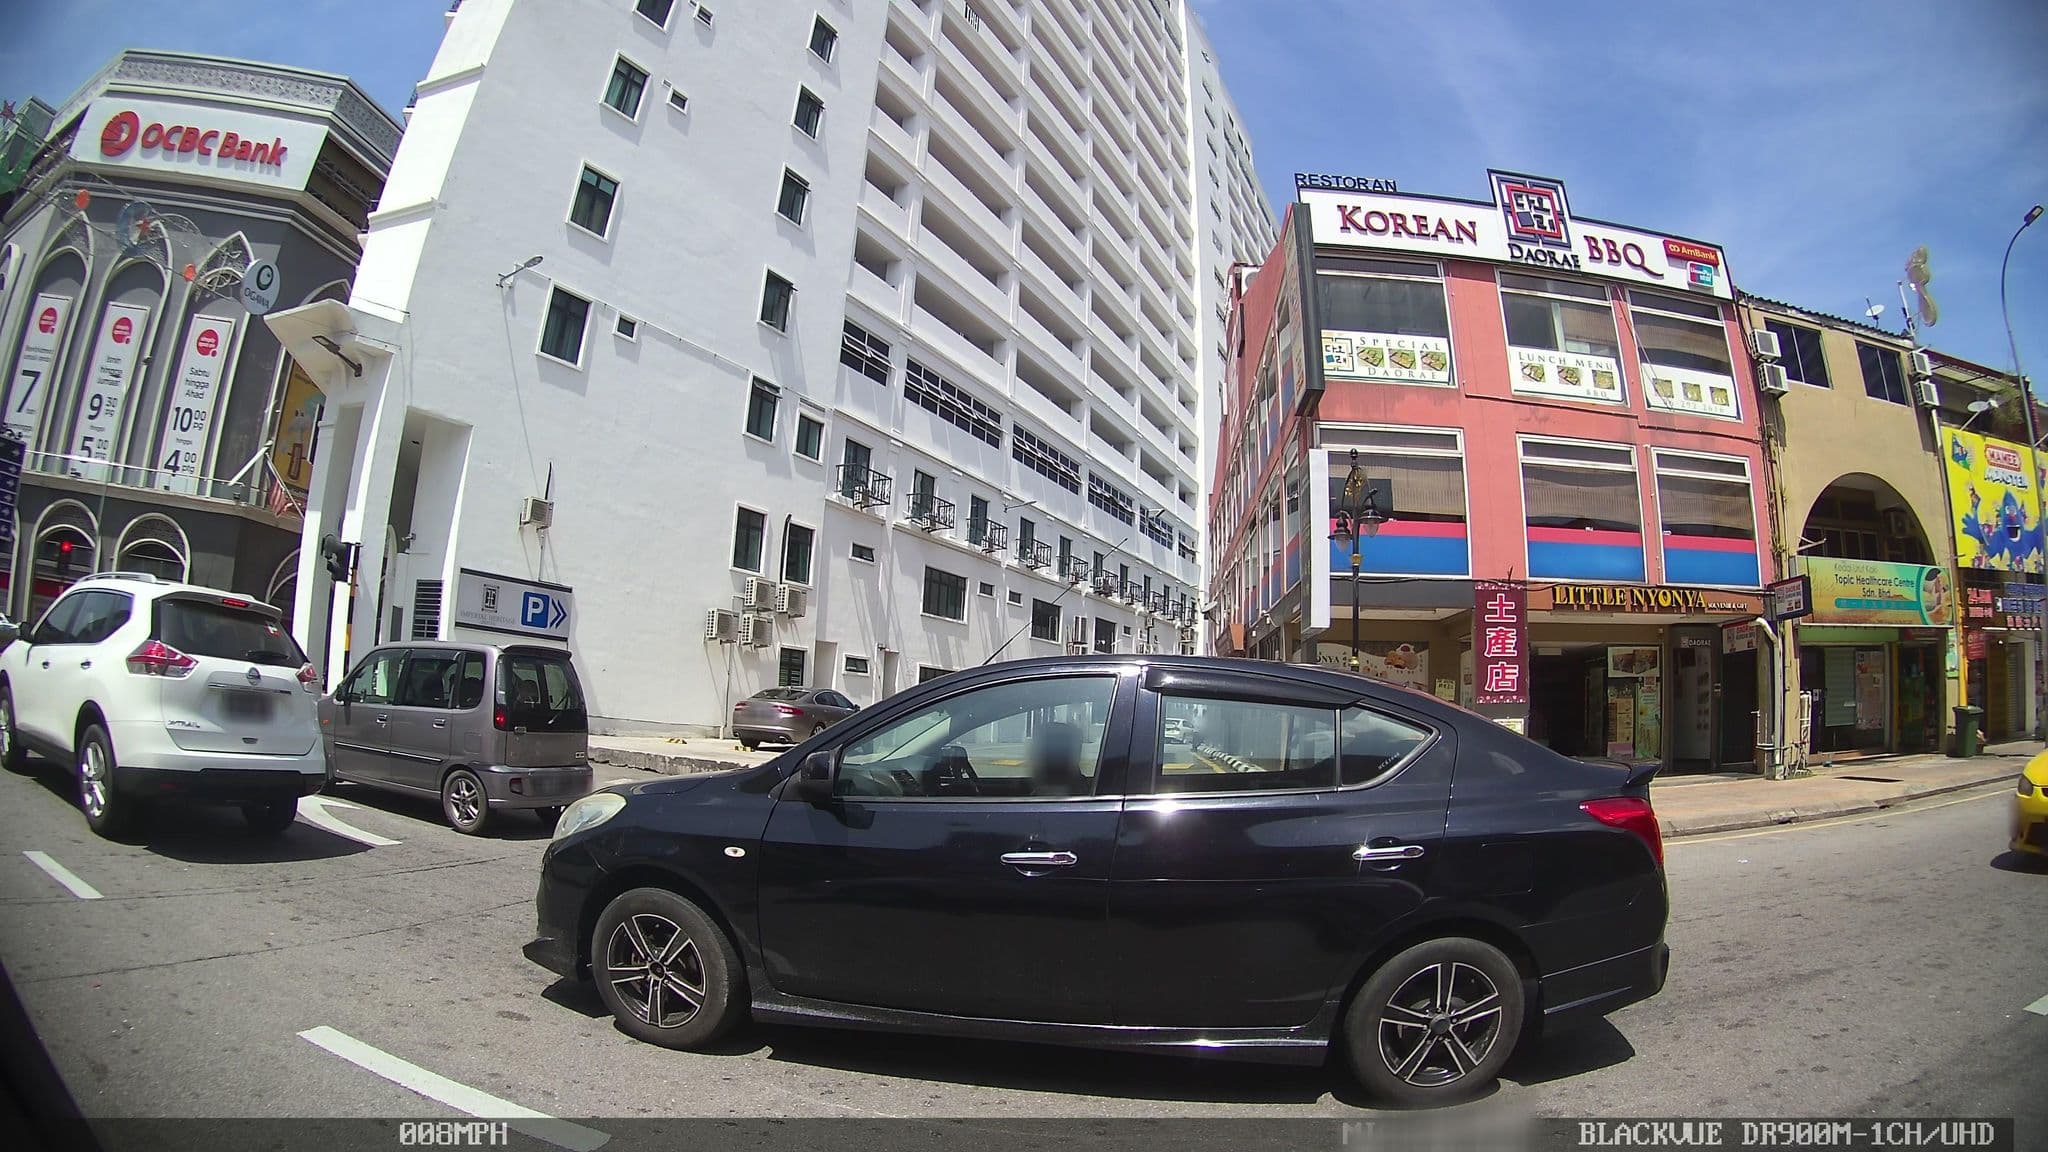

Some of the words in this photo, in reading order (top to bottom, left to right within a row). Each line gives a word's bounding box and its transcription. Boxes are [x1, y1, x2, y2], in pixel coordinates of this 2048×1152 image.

[141, 122, 219, 157] OCBC
[218, 131, 288, 167] Bank
[1295, 173, 1398, 193] RESTORAN
[1337, 204, 1477, 244] KOREAN
[1508, 243, 1581, 269] DAORAE
[1584, 235, 1664, 277] BBQ
[1681, 246, 1716, 260] AmBank
[1359, 336, 1441, 351] SPECIAL
[189, 366, 211, 379] Sabtu
[1367, 366, 1438, 380] DAORAE
[1518, 351, 1567, 366] LUNCH
[1575, 358, 1614, 370] MENU
[16, 368, 42, 413] 7
[184, 378, 210, 391] hingga
[184, 389, 206, 400] Ahad
[87, 393, 104, 421] 9
[172, 406, 194, 433] 10
[194, 409, 208, 422] 00
[79, 435, 95, 463] 5
[163, 449, 182, 477] 4
[183, 452, 198, 464] 00
[1835, 573, 1856, 586] Topic
[1856, 575, 1893, 587] Healthcare
[1894, 577, 1916, 588] Centre
[526, 595, 545, 623] P
[1554, 586, 1627, 606] LITTLE
[1632, 587, 1706, 609] NYONYA
[1483, 592, 1521, 693] 土產店
